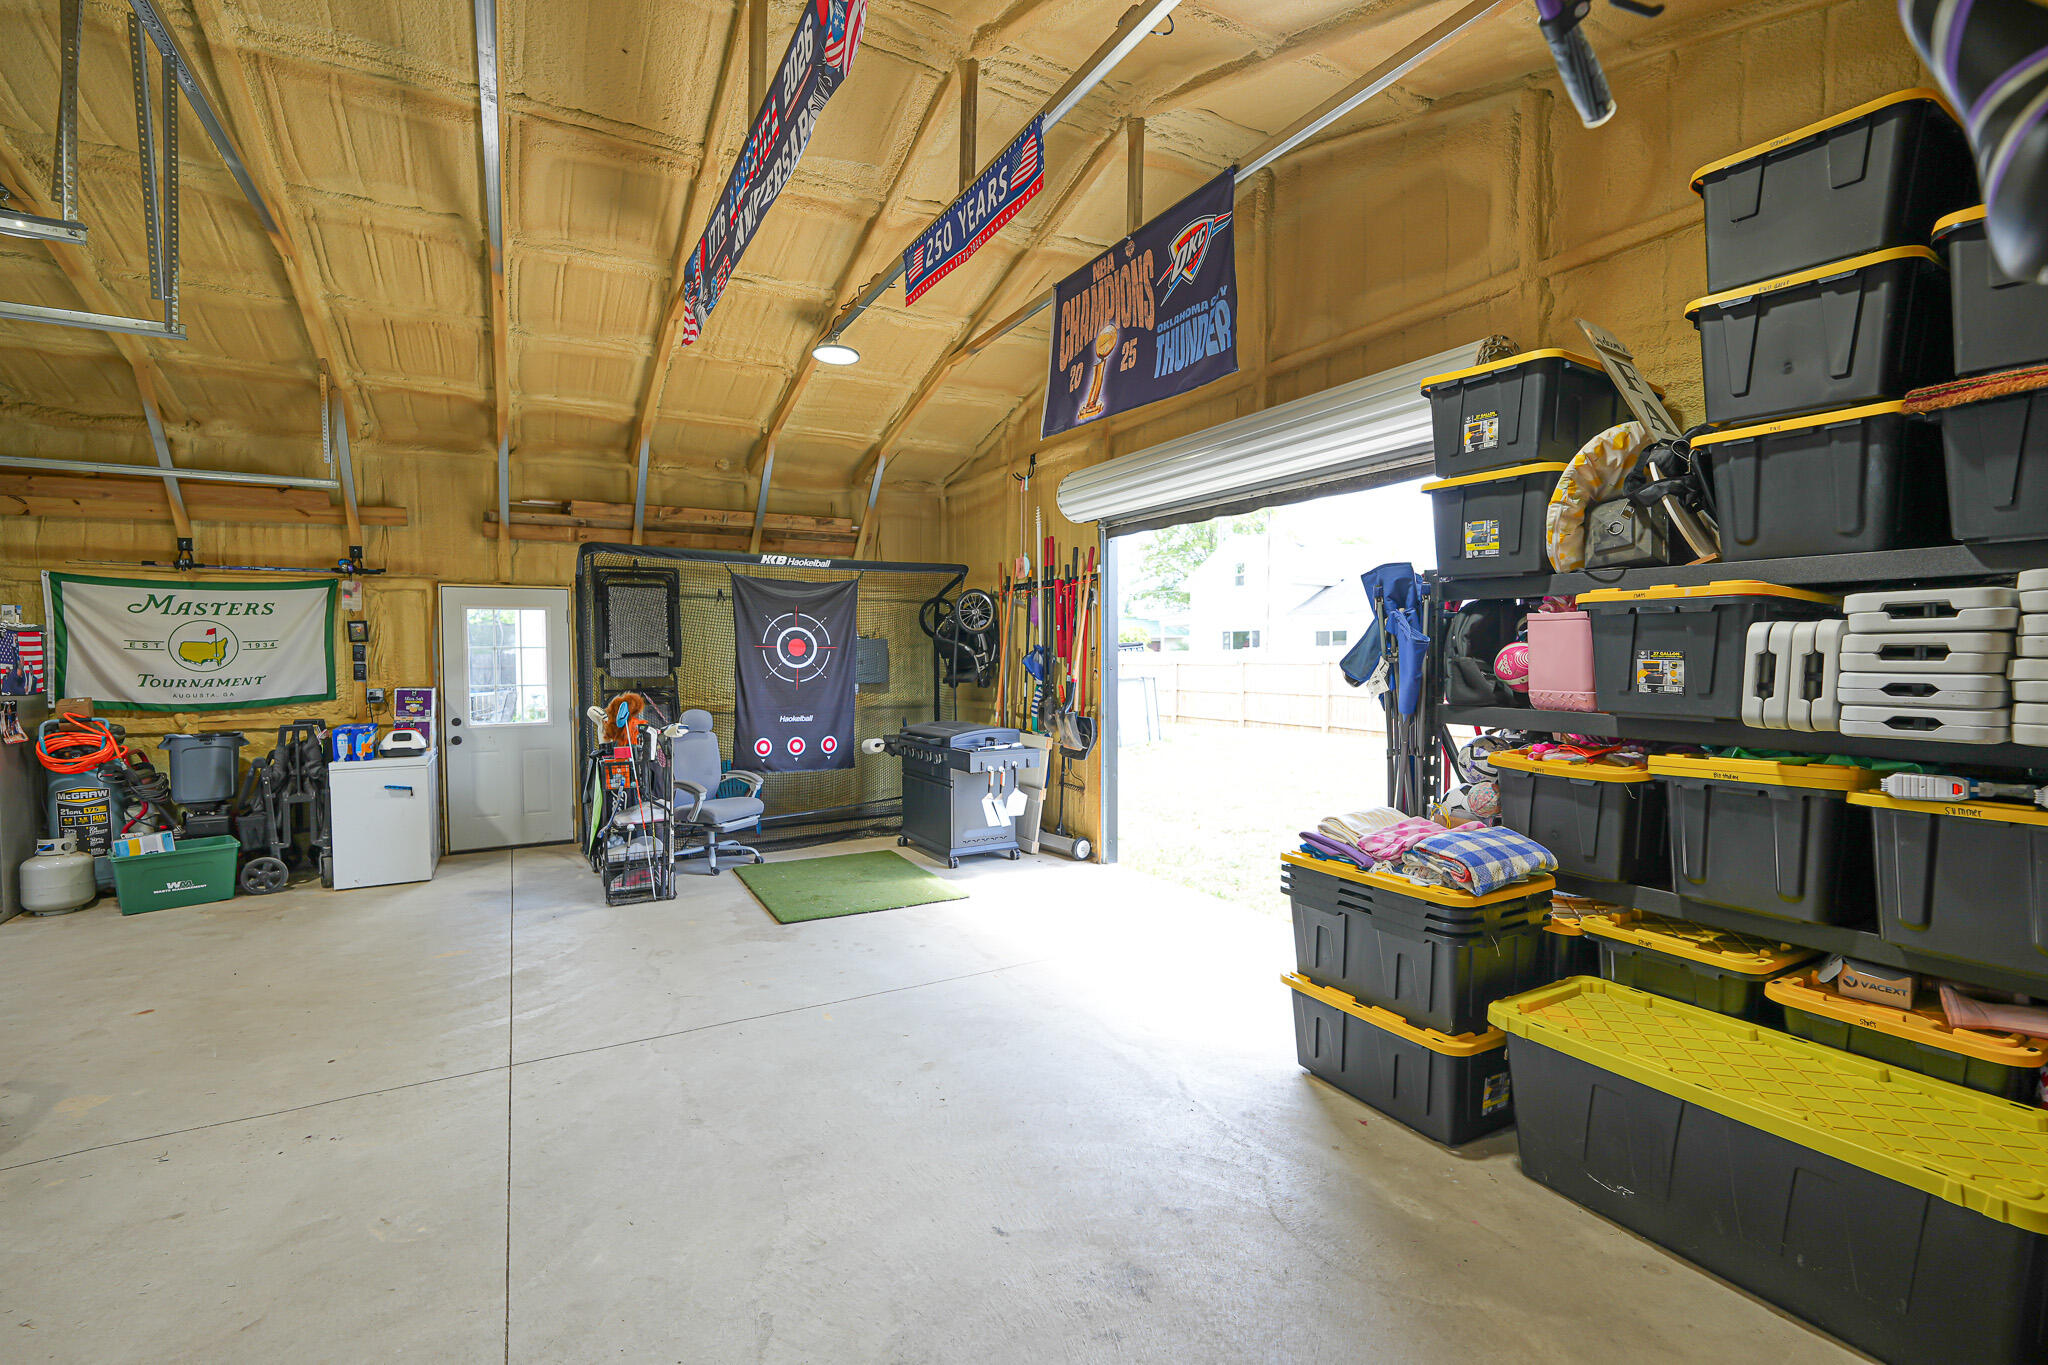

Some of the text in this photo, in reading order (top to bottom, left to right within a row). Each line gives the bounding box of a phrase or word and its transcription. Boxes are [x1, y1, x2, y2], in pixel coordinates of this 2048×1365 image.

[707, 204, 726, 260] 1776
[783, 13, 815, 109] 2026
[925, 164, 1008, 268] 250 YEARS
[1092, 251, 1115, 284] NBA
[1171, 225, 1207, 283] OKC
[1059, 248, 1155, 373] CHAMPIONS
[1157, 300, 1209, 333] OKLAHOMA
[1153, 299, 1232, 379] THUNDER
[1069, 337, 1138, 393] 20 25
[127, 594, 275, 616] MASTERS
[129, 641, 275, 649] EST 1934
[137, 673, 267, 688] TOURNAMENT
[1861, 981, 1909, 997] VACEXT
